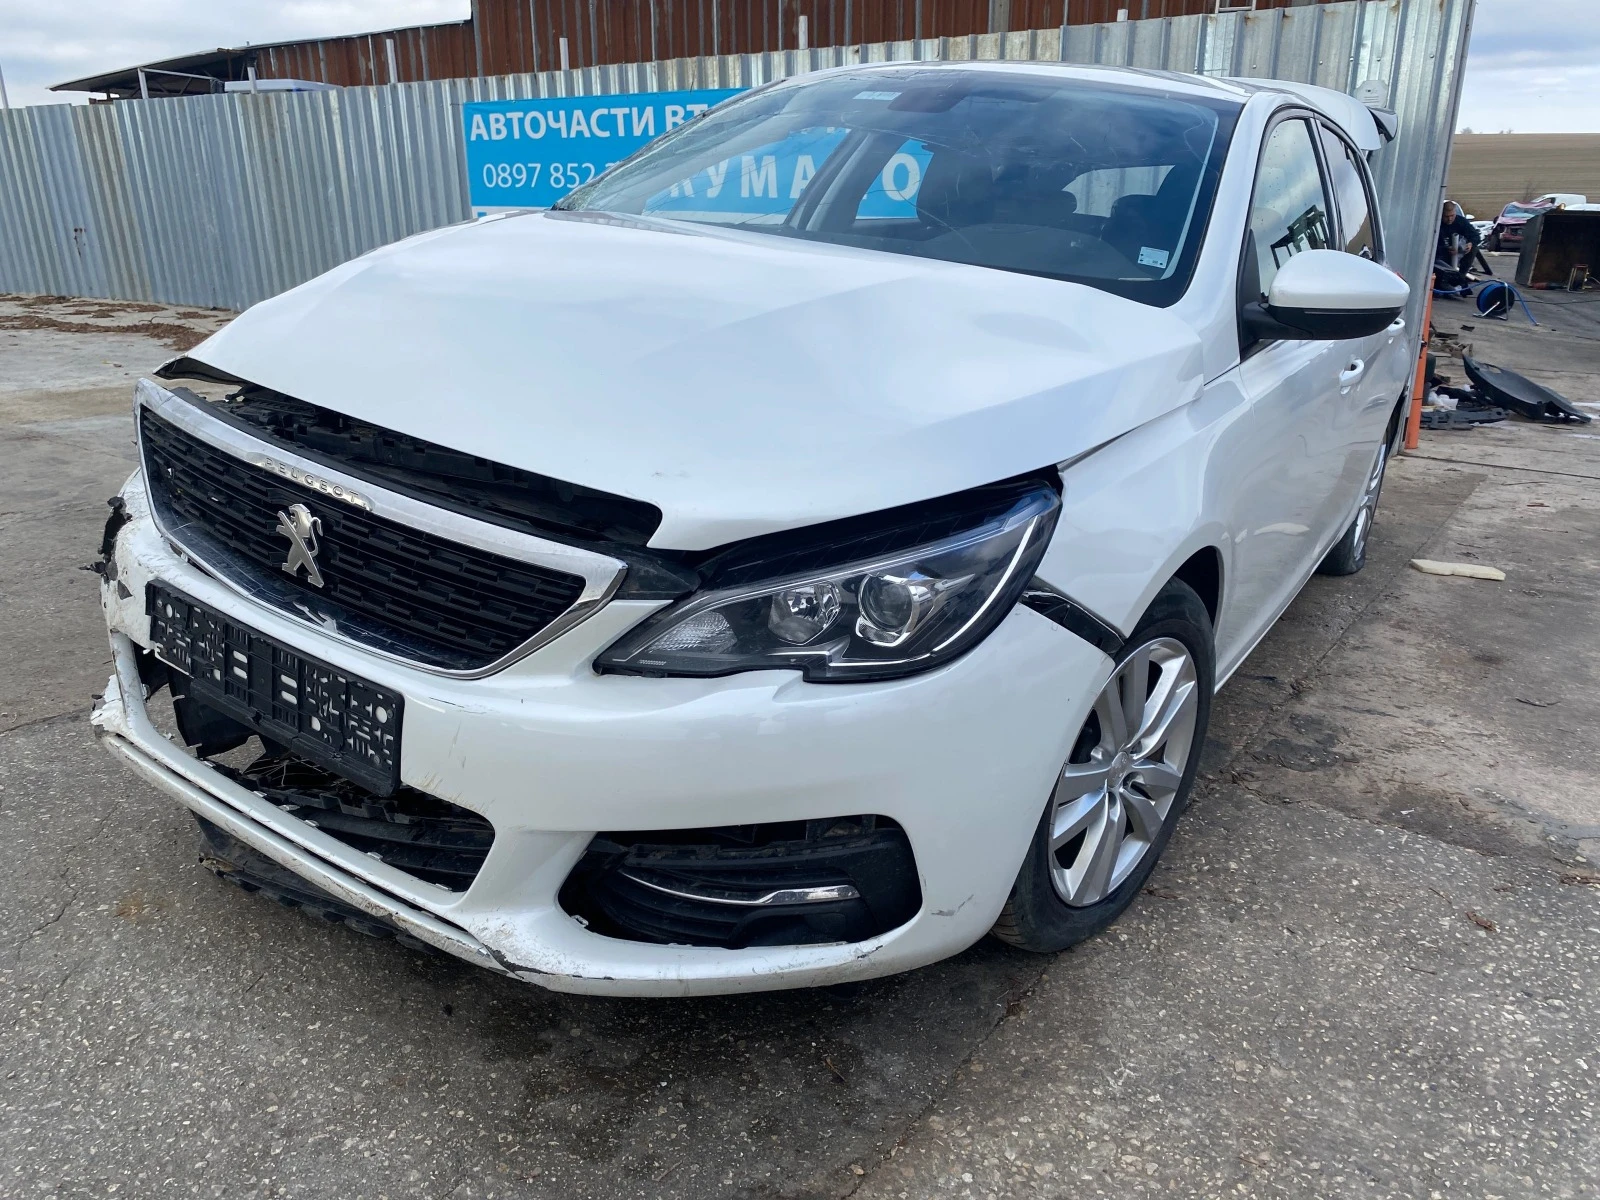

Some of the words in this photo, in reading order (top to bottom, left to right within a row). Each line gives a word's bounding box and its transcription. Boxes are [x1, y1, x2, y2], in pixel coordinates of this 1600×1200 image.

[470, 106, 656, 141] АВТОЧАСТИ
[483, 163, 541, 188] 0897
[550, 162, 595, 189] 852
[264, 457, 359, 503] PEUGEOT
